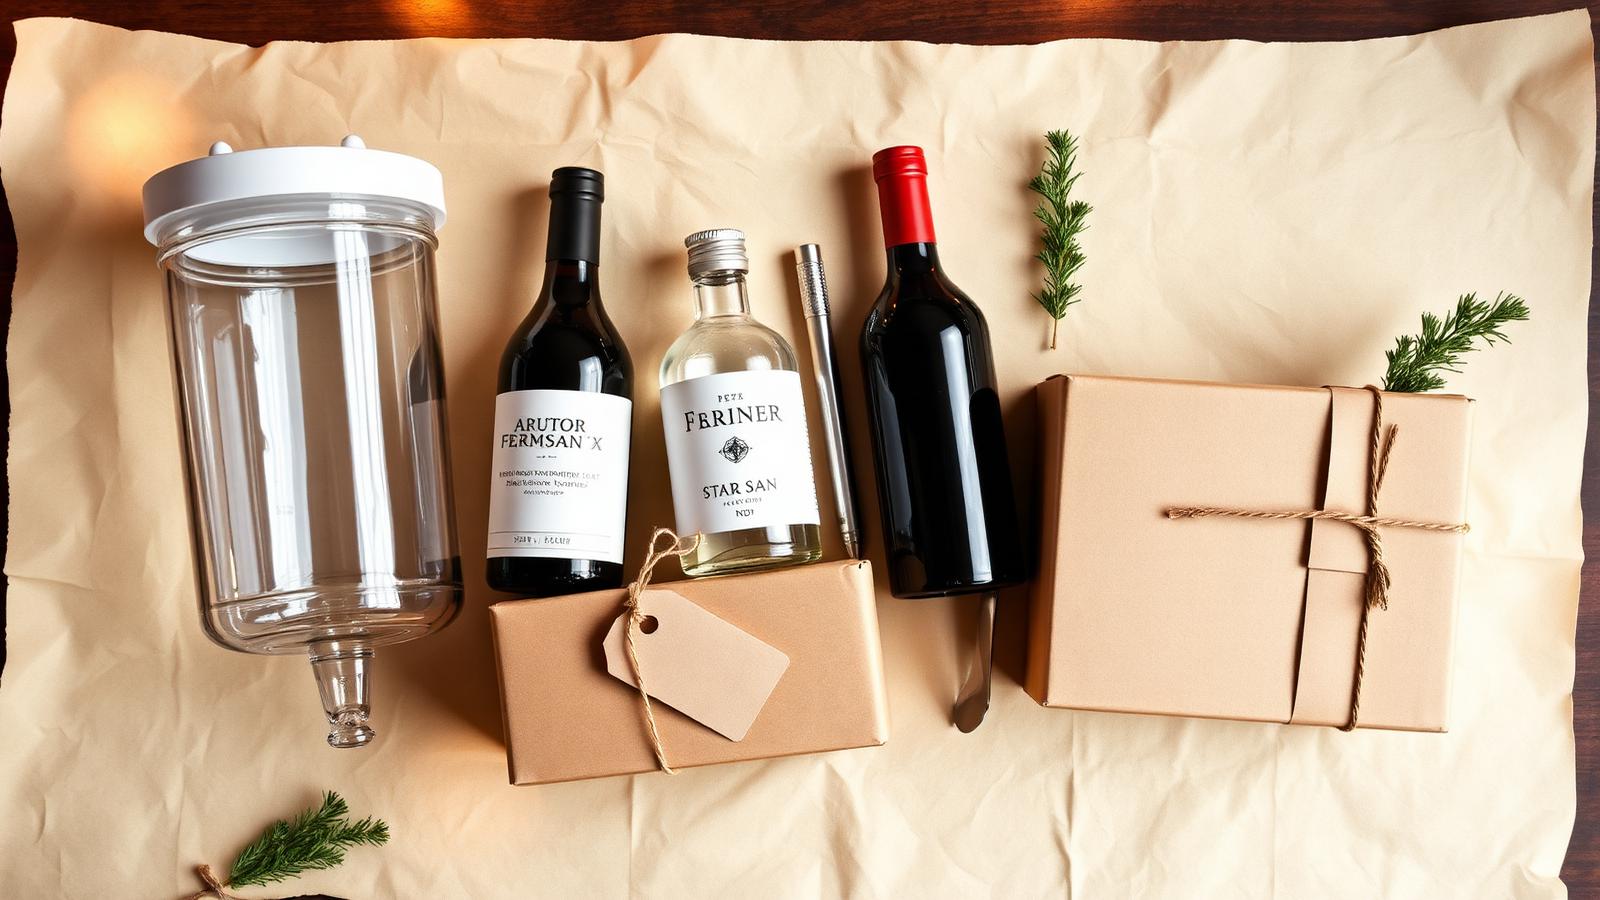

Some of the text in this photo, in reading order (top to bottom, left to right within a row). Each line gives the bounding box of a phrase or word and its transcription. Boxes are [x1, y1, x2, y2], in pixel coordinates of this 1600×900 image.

[513, 417, 586, 433] ARUTOR
[703, 478, 778, 499] STAR SAN
